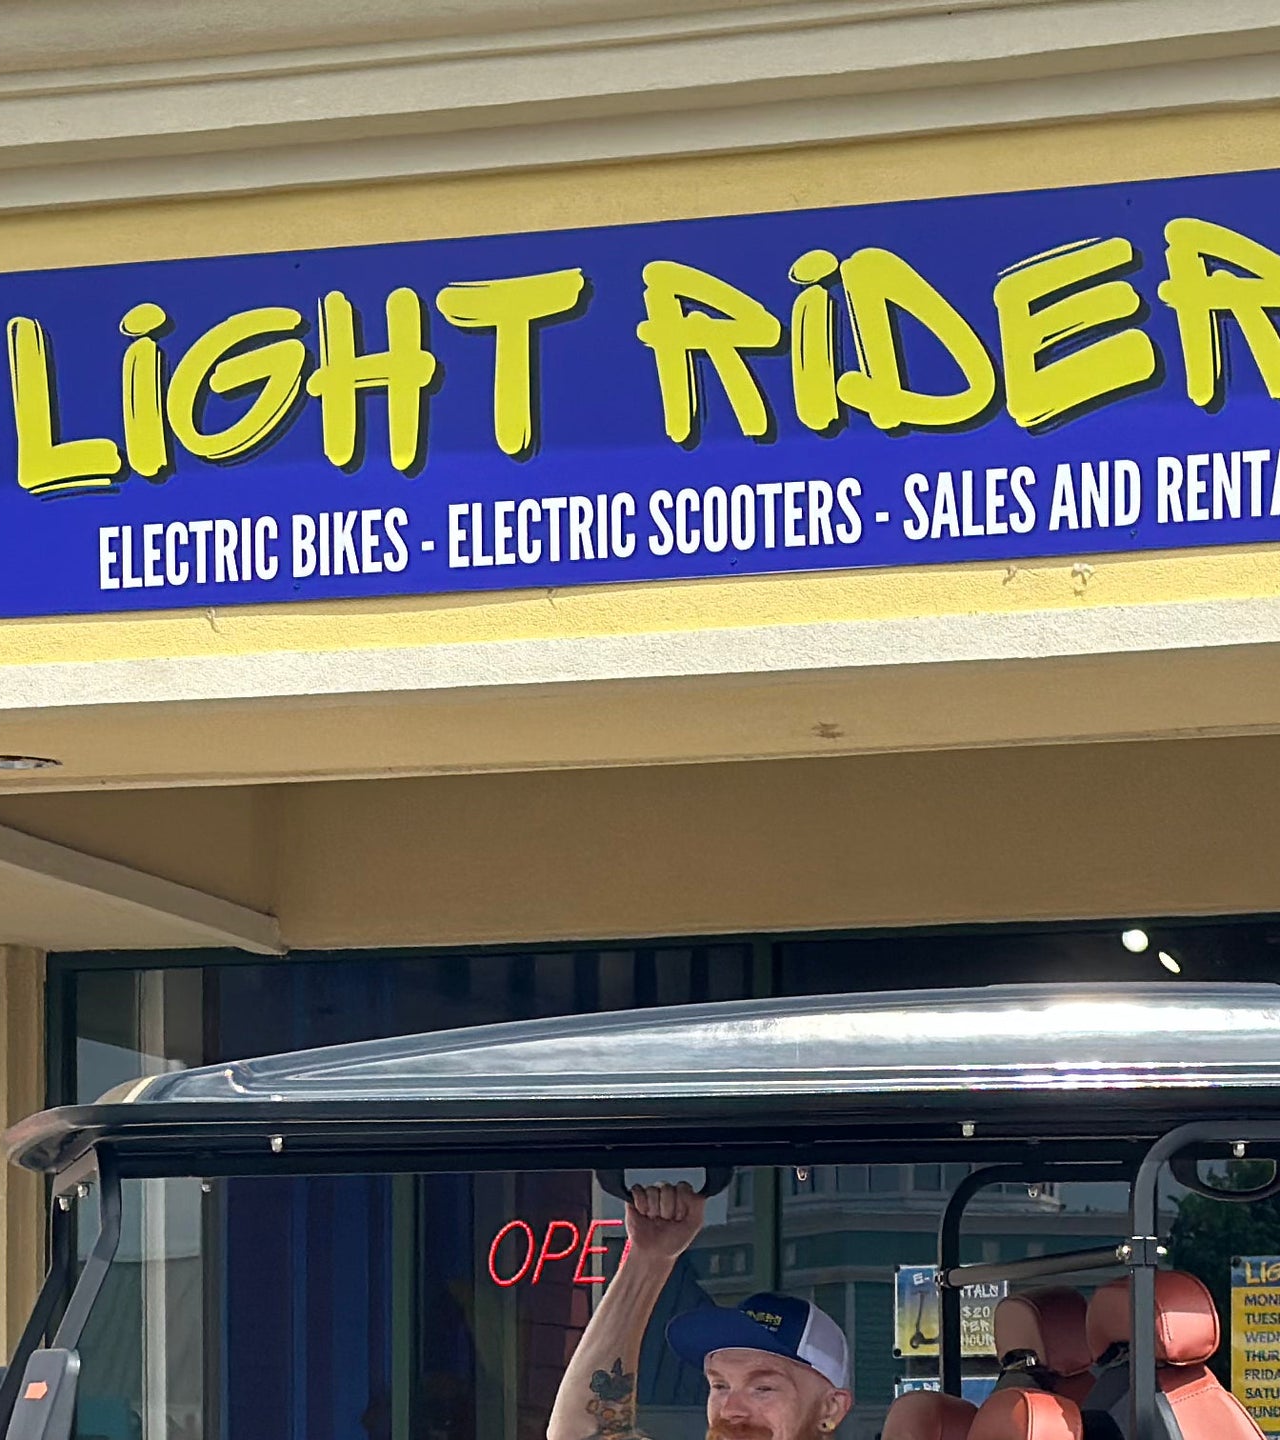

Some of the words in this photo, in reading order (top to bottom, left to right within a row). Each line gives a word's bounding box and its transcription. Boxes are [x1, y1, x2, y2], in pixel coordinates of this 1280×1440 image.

[99, 515, 280, 590] ELECTRIC
[291, 506, 410, 578] BIKES
[447, 492, 636, 569] ELECTRIC
[648, 477, 863, 556] SCOOTERS
[902, 465, 1037, 542] SALES
[1048, 459, 1142, 532] AND
[488, 1219, 633, 1288] OPE
[962, 1305, 991, 1318] $20
